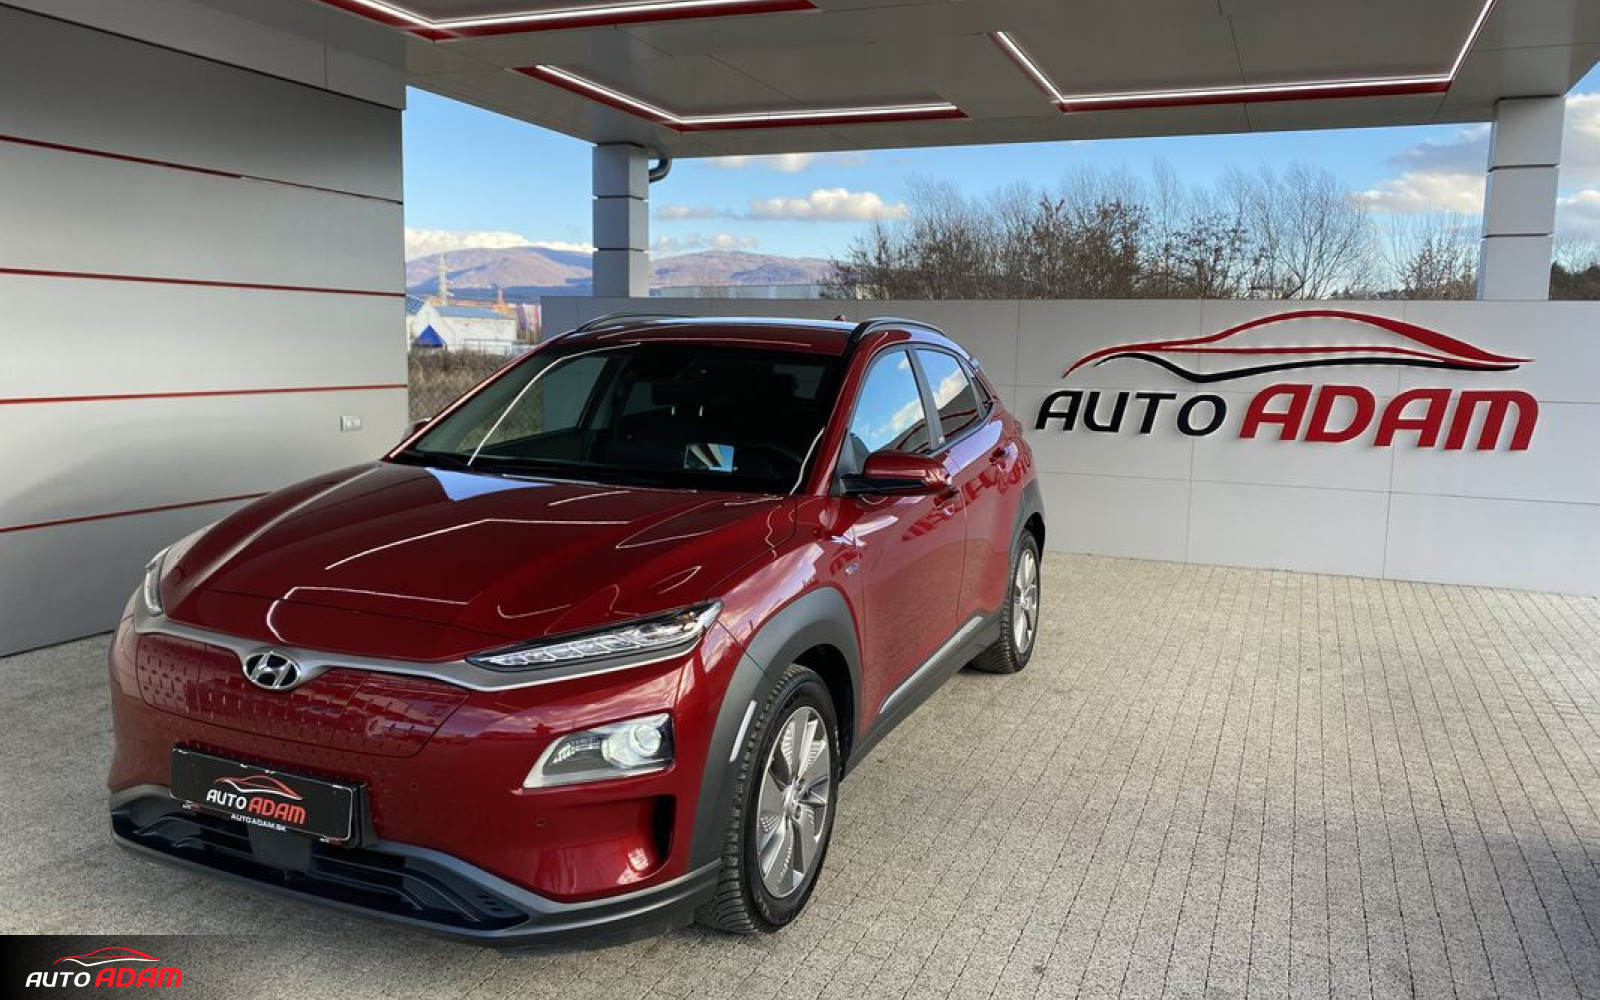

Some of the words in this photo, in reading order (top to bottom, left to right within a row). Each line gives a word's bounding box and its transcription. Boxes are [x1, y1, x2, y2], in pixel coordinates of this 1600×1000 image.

[1035, 390, 1227, 437] AUTO
[1239, 383, 1539, 452] ADAM
[206, 788, 247, 810] AUTO
[248, 796, 306, 825] ADAM
